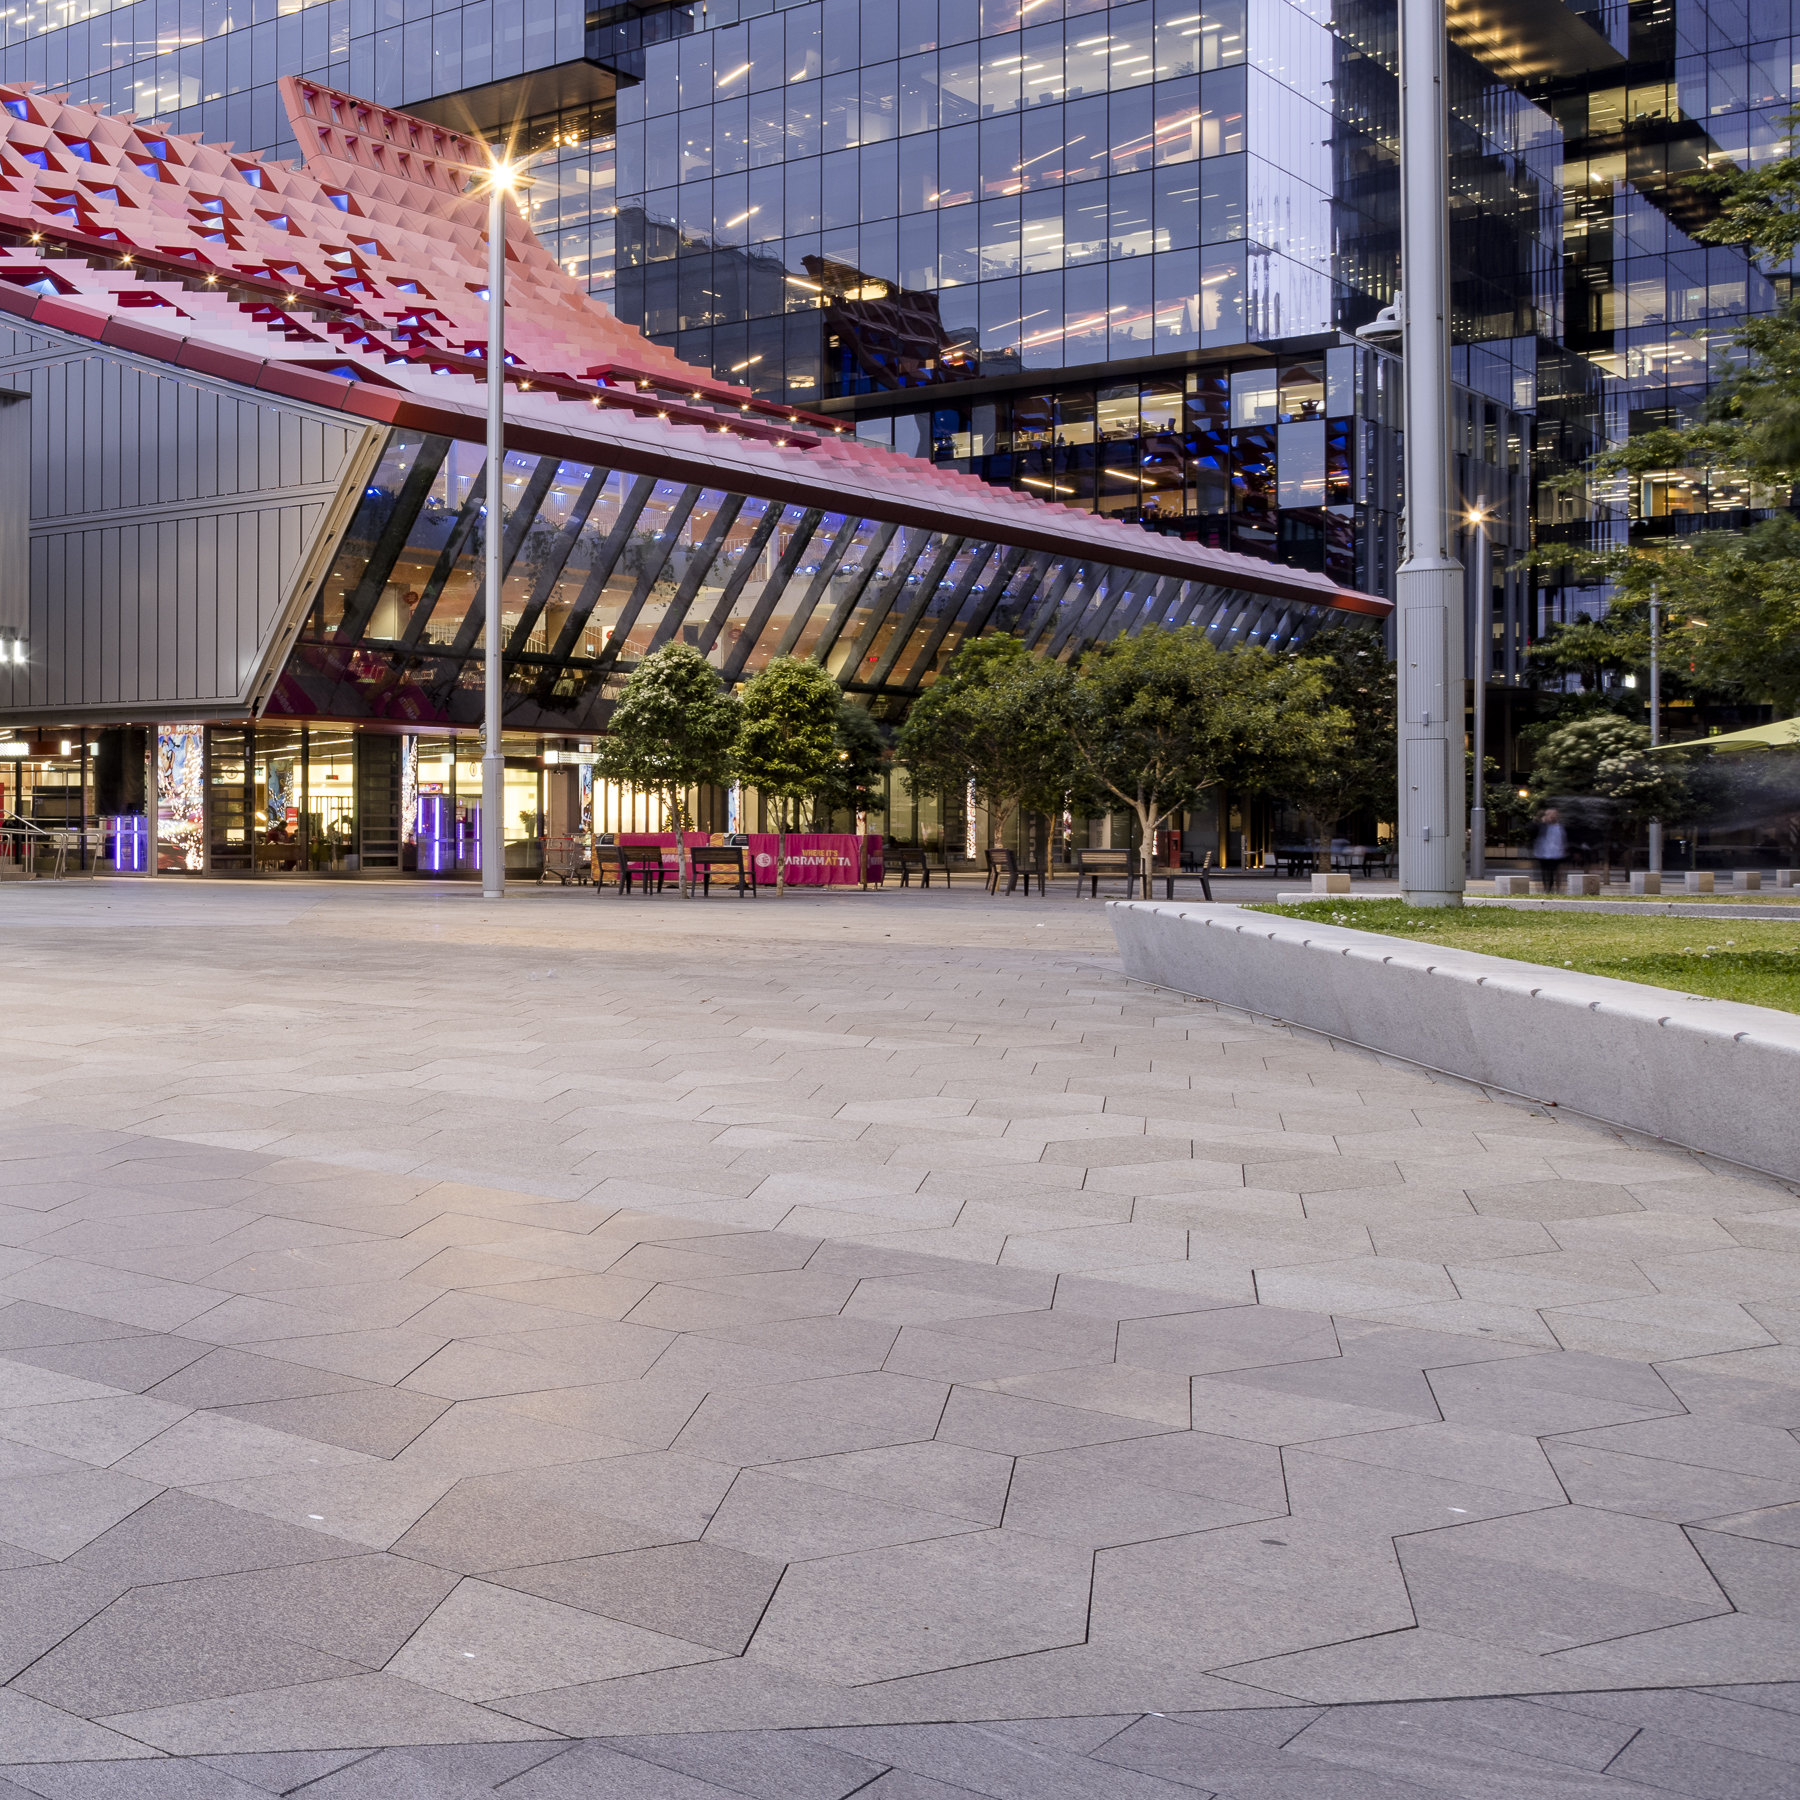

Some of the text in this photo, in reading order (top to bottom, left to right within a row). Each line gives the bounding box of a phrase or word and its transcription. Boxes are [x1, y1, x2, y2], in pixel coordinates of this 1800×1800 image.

[802, 849, 838, 857] WHERE IT'S
[781, 855, 851, 867] ARRAMATTA
